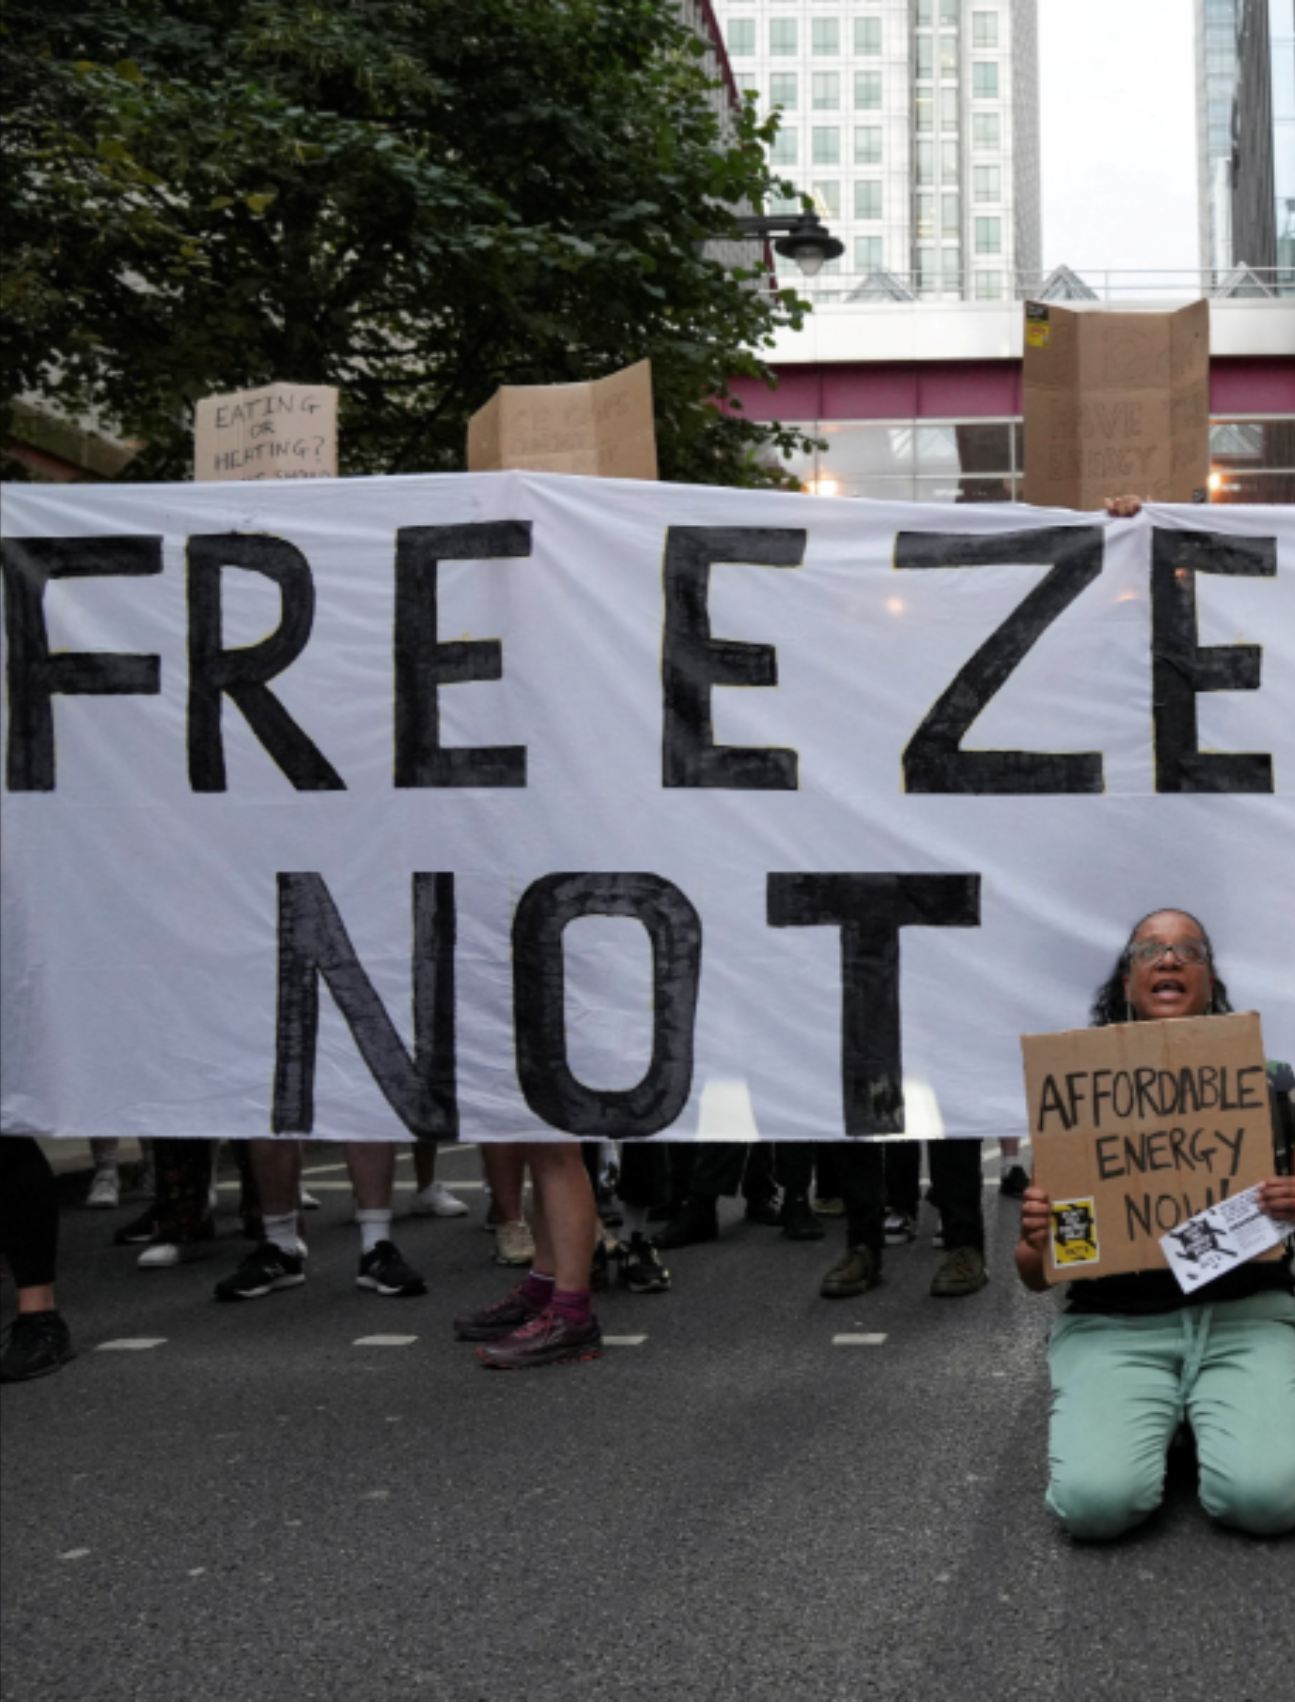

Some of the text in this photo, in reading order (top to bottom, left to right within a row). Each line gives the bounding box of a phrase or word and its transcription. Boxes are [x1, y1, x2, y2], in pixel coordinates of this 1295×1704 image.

[215, 394, 321, 428] EATING
[250, 420, 276, 439] OR
[214, 436, 325, 471] HEATING?
[1, 519, 1278, 794] FREEZE
[272, 871, 981, 1140] NOT
[1037, 1066, 1265, 1132] AFFORDABLE
[1094, 1128, 1245, 1181] ENERGY
